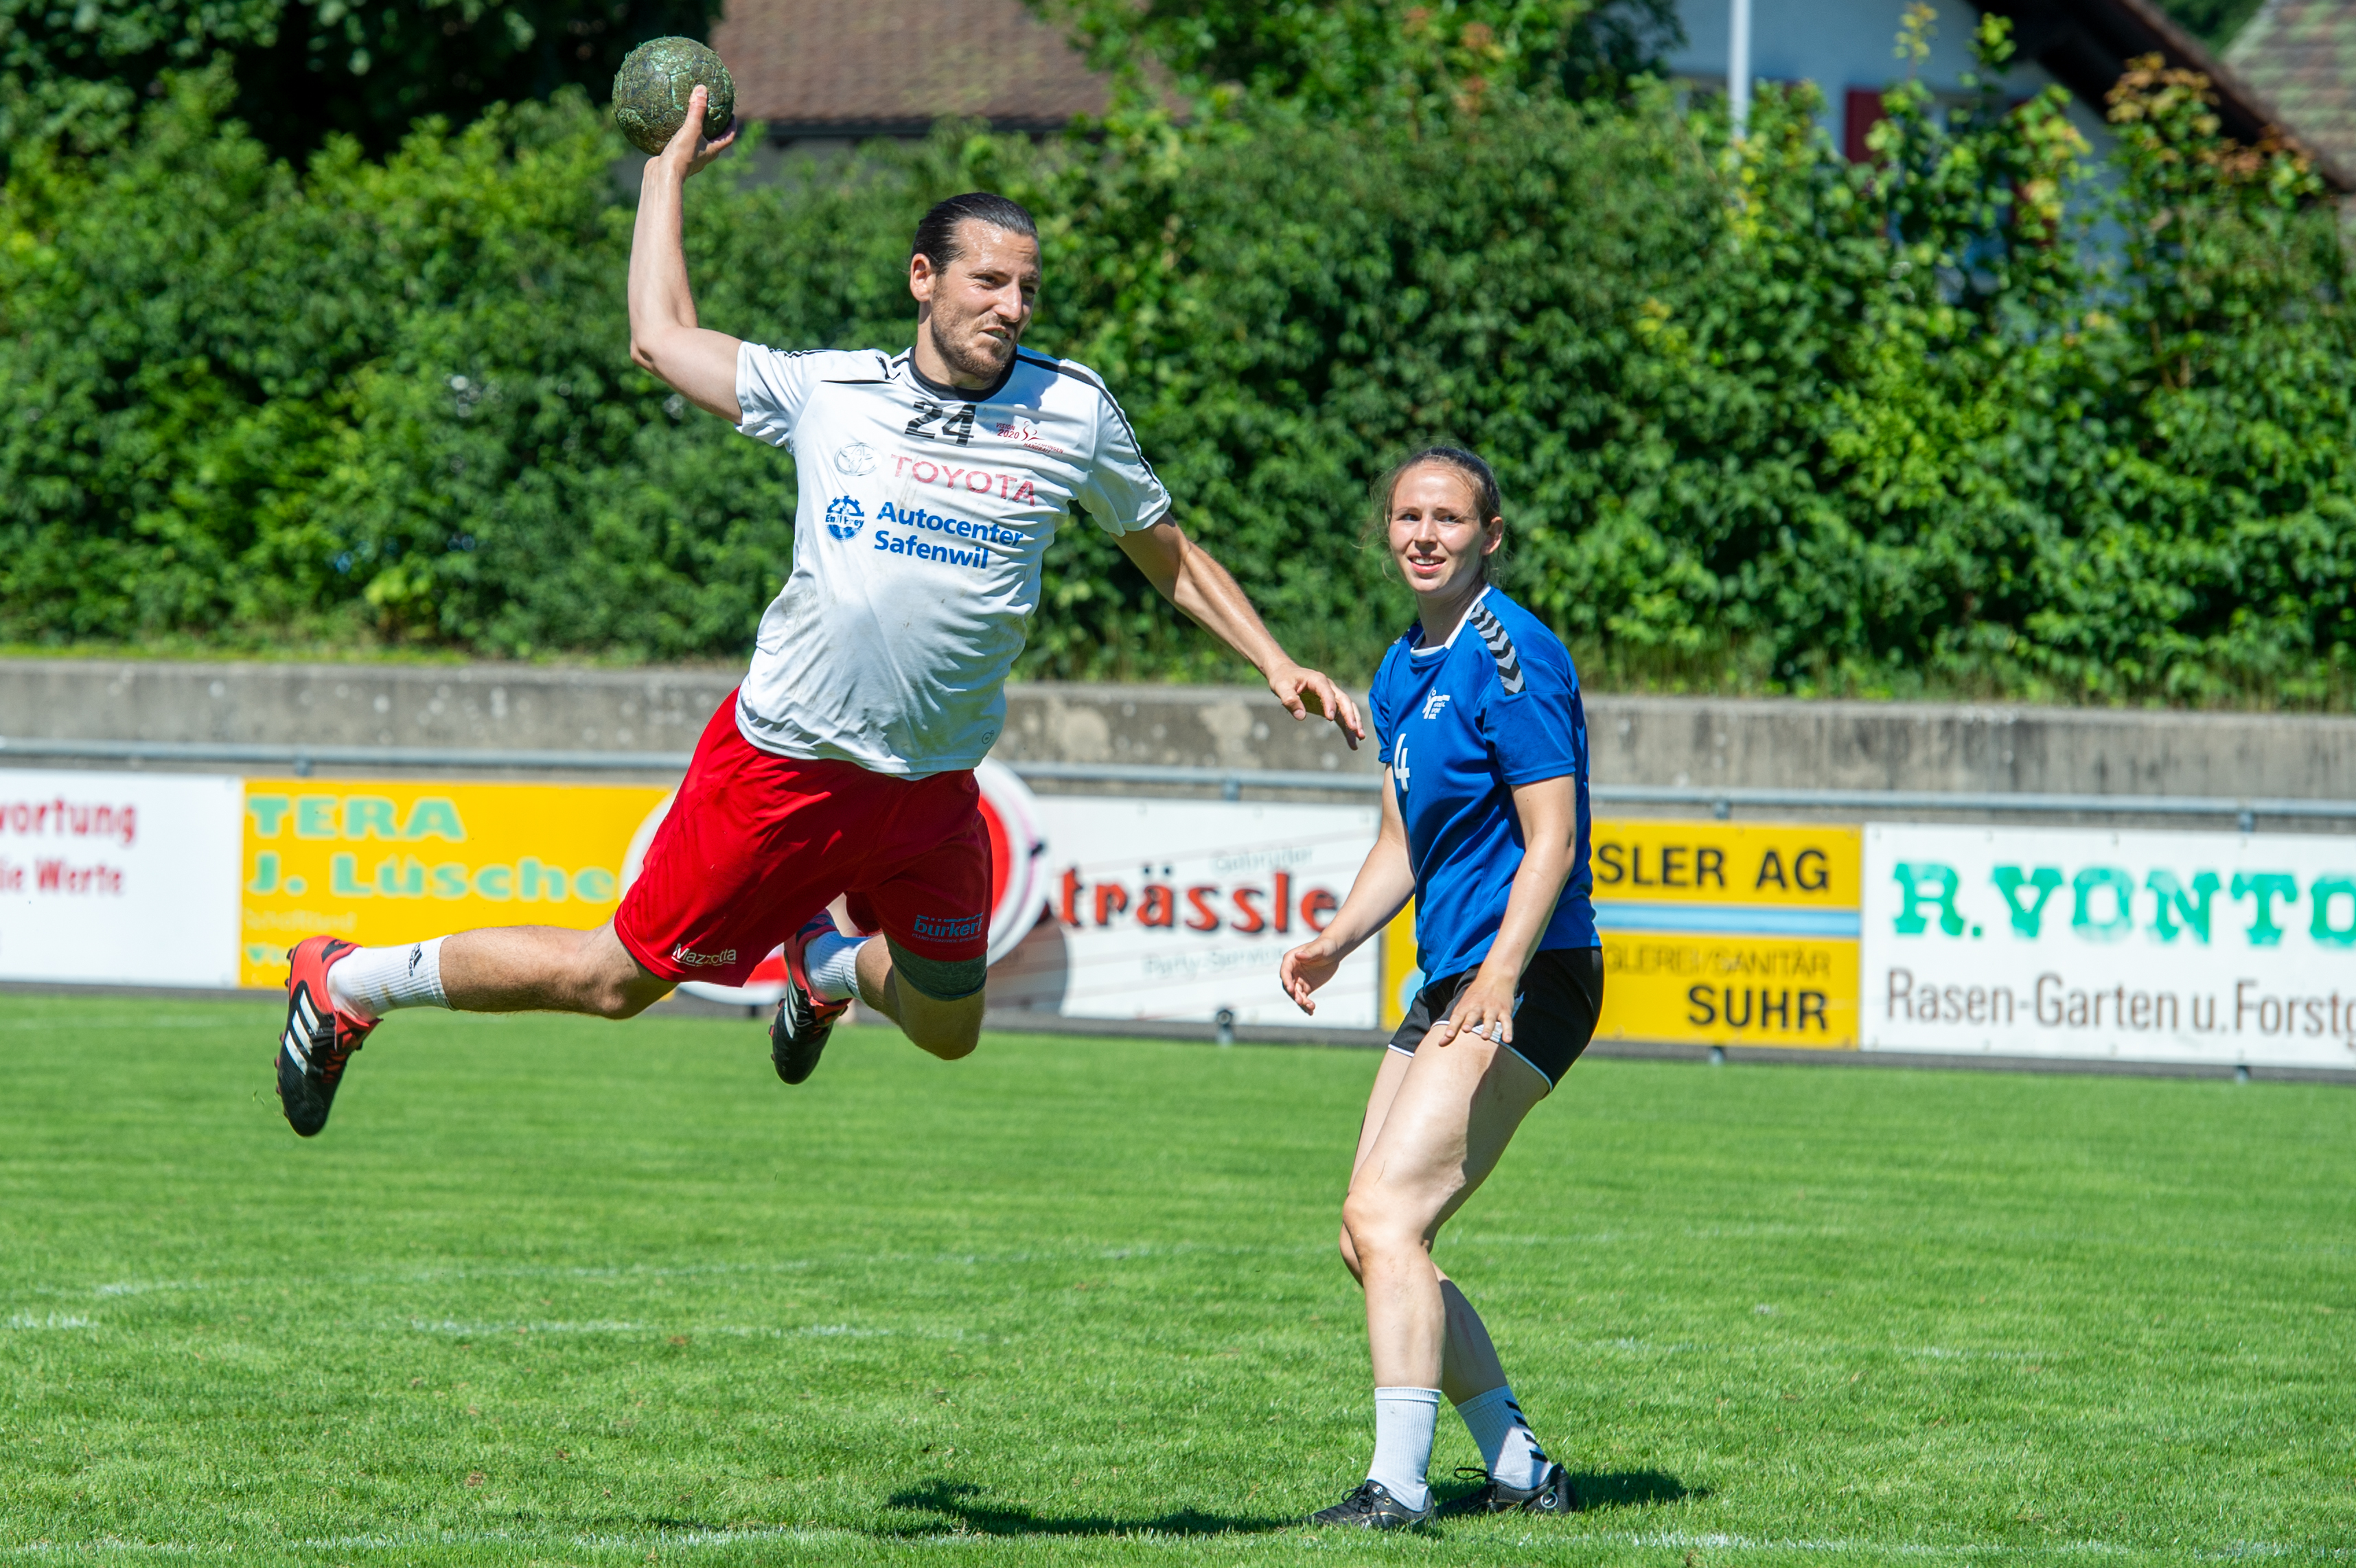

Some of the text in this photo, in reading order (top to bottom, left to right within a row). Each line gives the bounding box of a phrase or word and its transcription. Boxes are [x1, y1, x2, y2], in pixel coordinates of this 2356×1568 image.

[904, 401, 976, 446] 24
[996, 422, 1015, 430] VISION
[997, 429, 1019, 439] 2020
[1023, 443, 1051, 453] HANDBALL
[891, 453, 1036, 507] TOYOTA
[877, 502, 1024, 546] Autocenter
[874, 530, 989, 569] Safenwil
[1394, 733, 1410, 792] 4
[249, 796, 465, 840] TERA
[35, 856, 126, 895] Werte
[250, 852, 306, 894] J.
[1597, 843, 1830, 890] SLER AG
[1035, 864, 1338, 934] trässle
[1687, 984, 1827, 1031] SUHR
[1887, 969, 2179, 1030] Rasen-Garten
